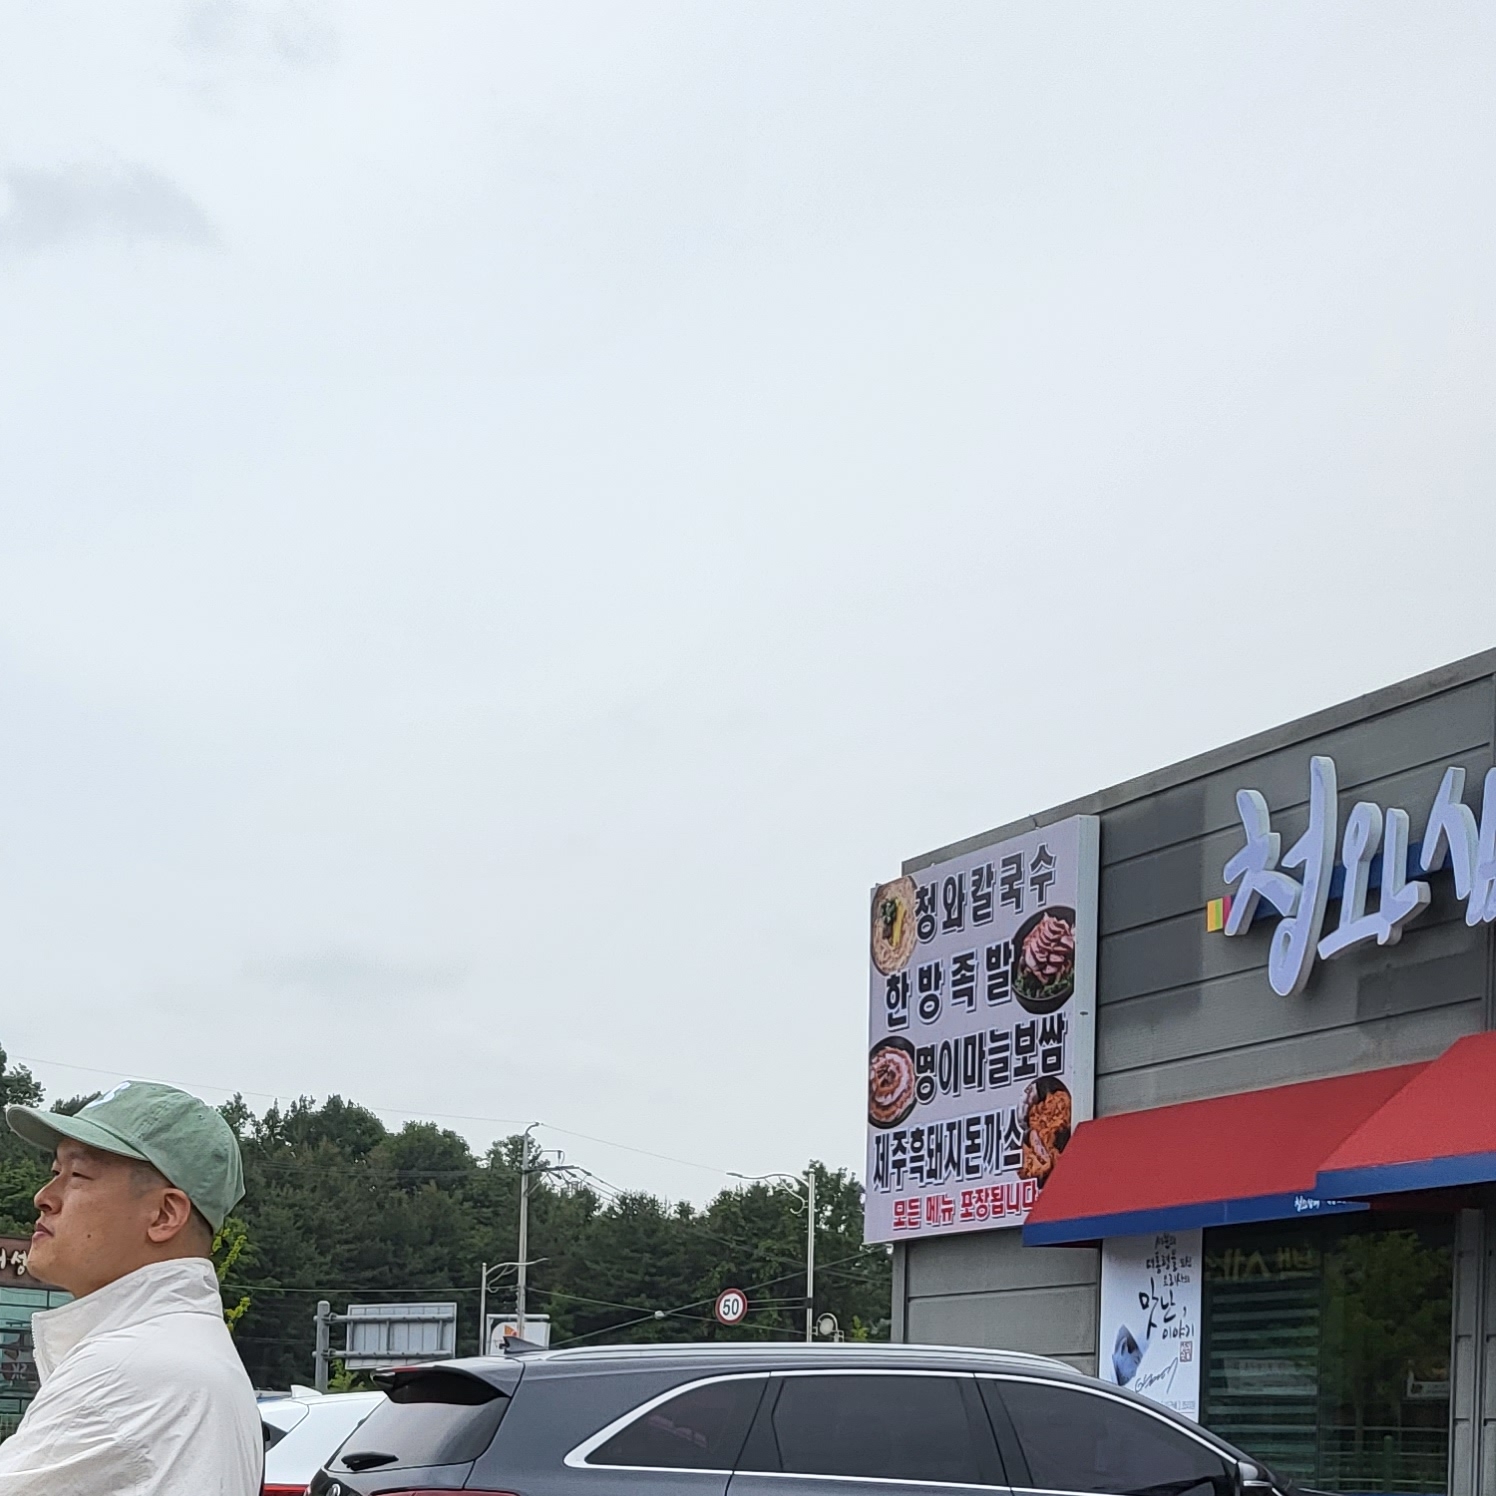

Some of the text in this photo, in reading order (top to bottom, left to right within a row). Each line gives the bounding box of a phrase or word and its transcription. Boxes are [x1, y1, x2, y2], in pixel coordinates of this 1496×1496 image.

[914, 843, 1055, 943] 청와칼국수
[885, 938, 1013, 1031] 한방족발
[915, 1012, 1066, 1103] 명이마늘보쌈
[873, 1106, 1024, 1191] 제주흑돼지돈까스
[892, 1179, 1040, 1229] 모든 메뉴 포장됩니다
[722, 1298, 740, 1316] 50
[1162, 1319, 1195, 1340] 이야기
